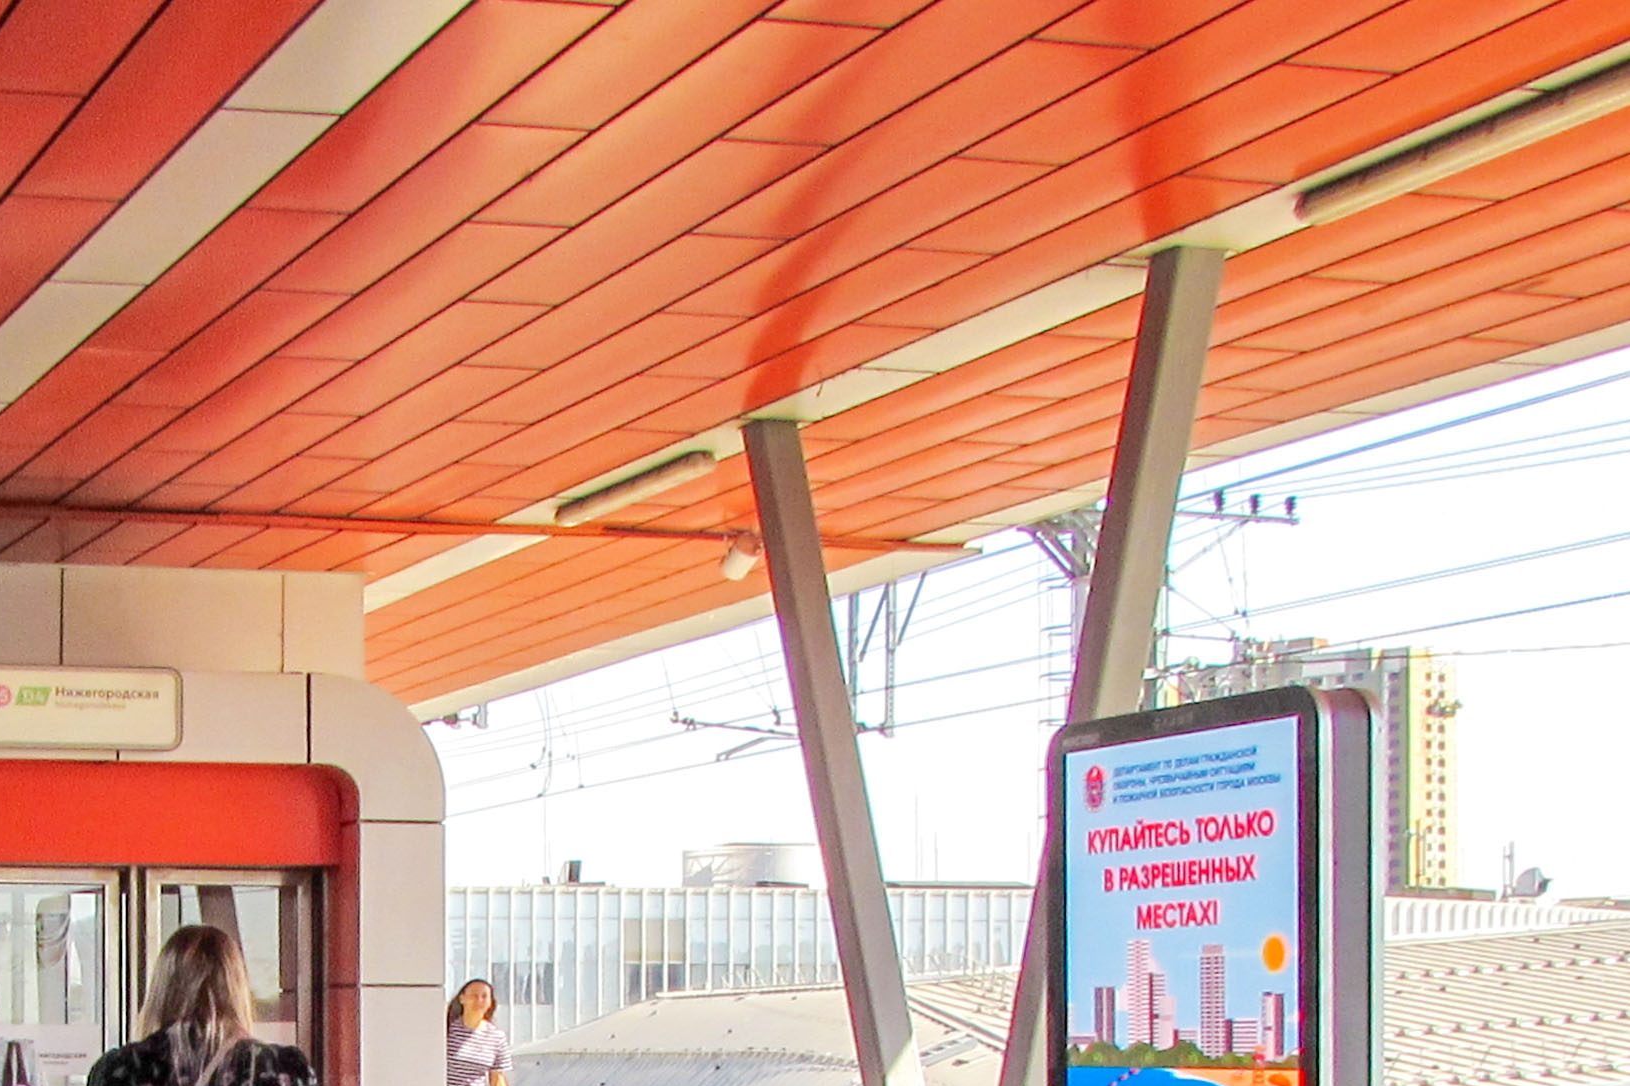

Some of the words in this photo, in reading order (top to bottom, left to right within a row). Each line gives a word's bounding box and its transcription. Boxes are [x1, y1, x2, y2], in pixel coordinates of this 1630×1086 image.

[55, 686, 159, 701] Нижегородская
[1087, 818, 1190, 855] КУПАЙТЕСЬ
[1196, 809, 1275, 843] ТОЛЬКО
[1103, 866, 1114, 893] В
[1120, 854, 1257, 892] РАЗРЕШЕННЫХ
[1136, 899, 1219, 930] МЕСТАХ!
